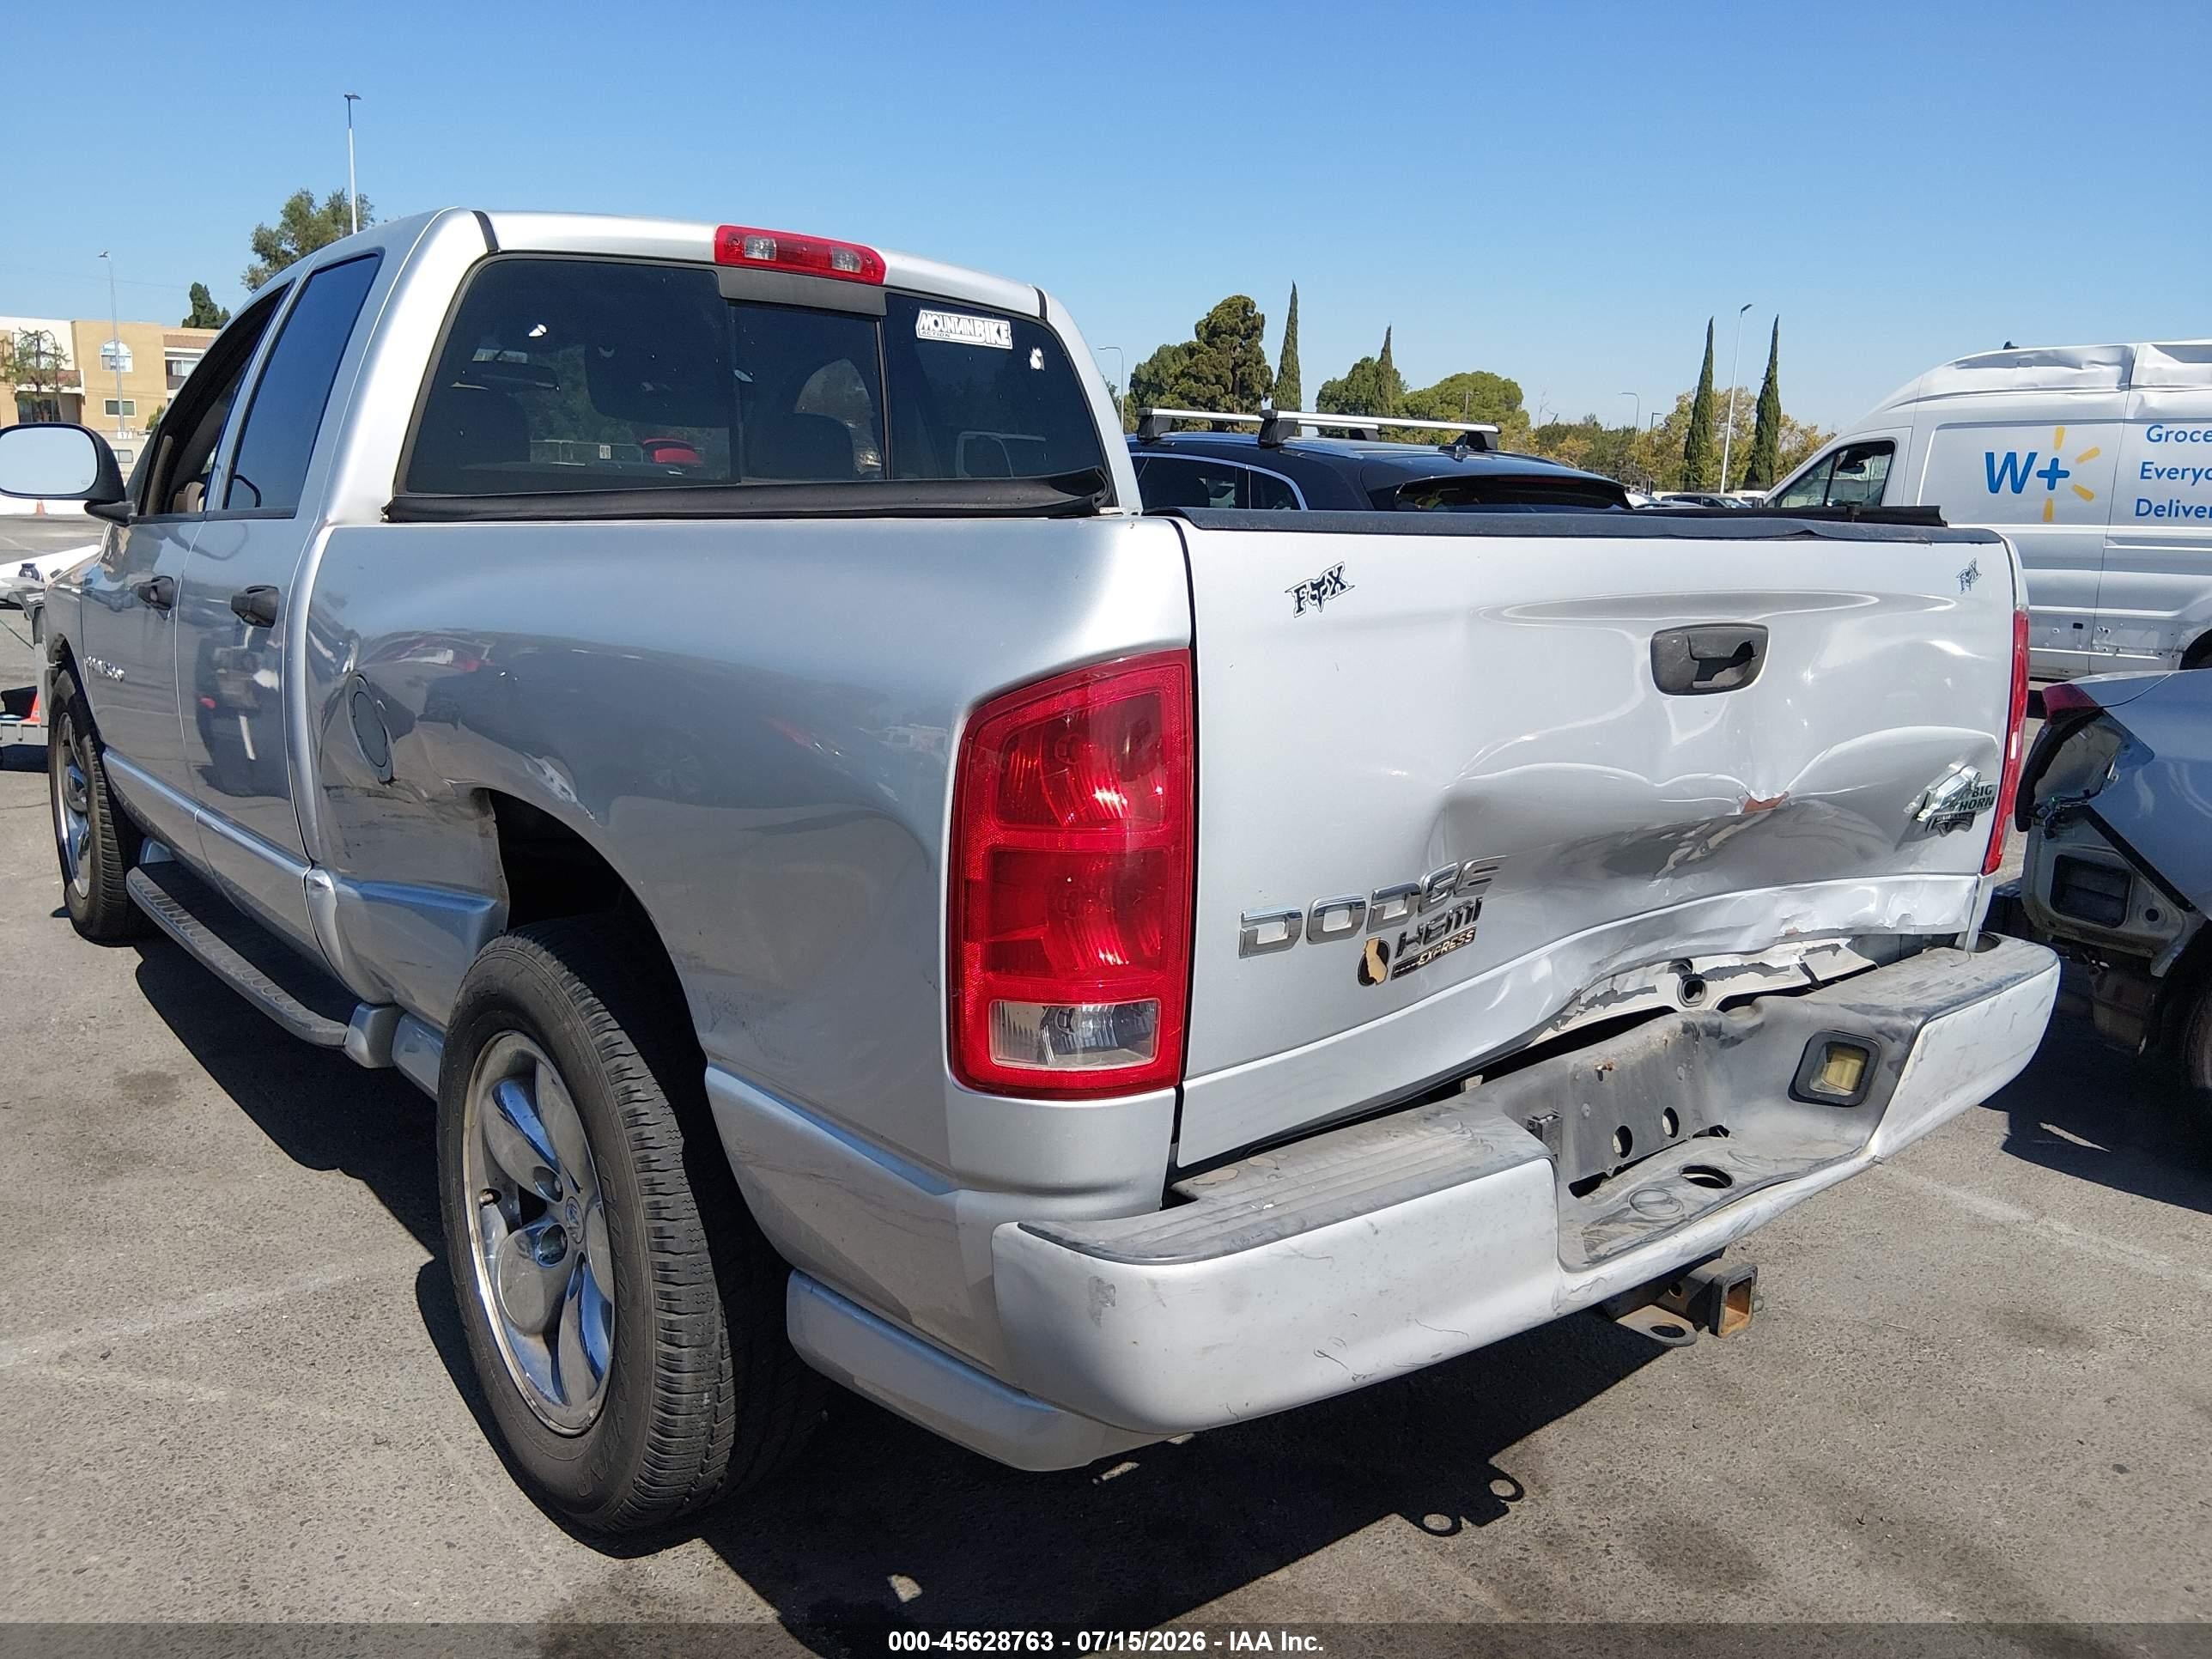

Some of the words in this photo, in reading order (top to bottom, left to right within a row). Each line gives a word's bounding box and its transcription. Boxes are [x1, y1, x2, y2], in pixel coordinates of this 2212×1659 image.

[1292, 564, 1347, 615] FOX
[1959, 795, 1995, 811] HORN
[1972, 784, 1993, 799] BIG
[1238, 854, 1507, 960] DODGE
[1417, 928, 1476, 967] EXPRESS
